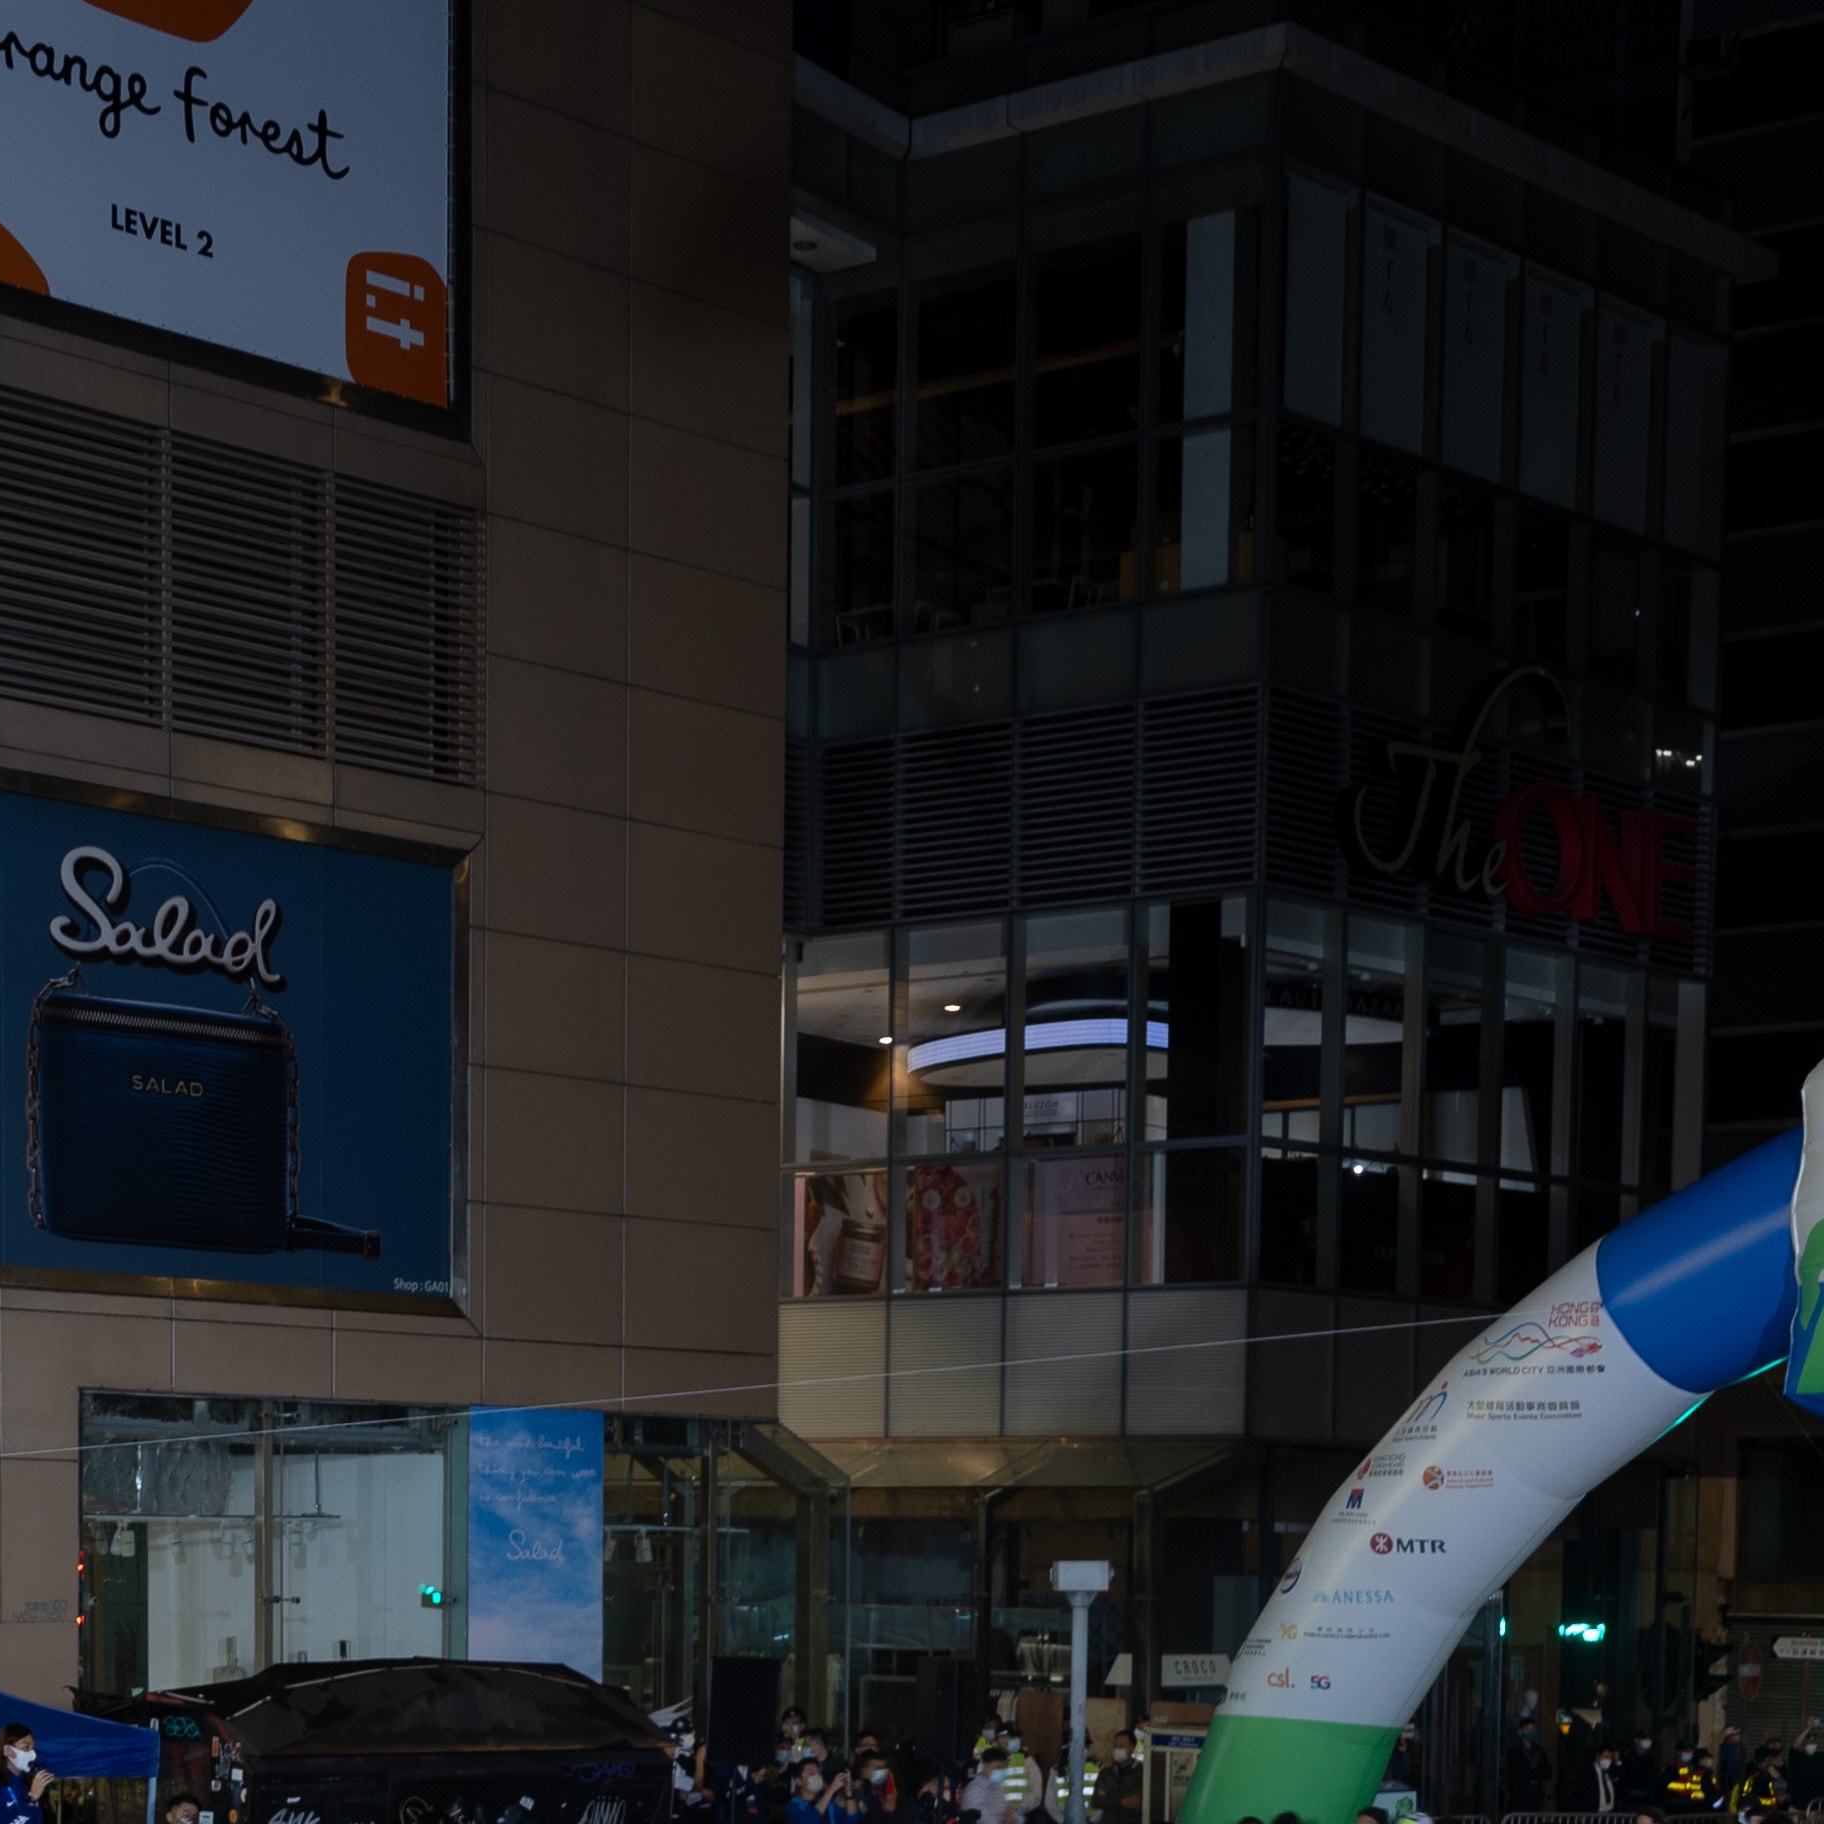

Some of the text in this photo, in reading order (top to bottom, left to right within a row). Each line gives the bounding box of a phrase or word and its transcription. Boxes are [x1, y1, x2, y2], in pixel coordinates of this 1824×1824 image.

[172, 65, 350, 181] forest
[110, 202, 214, 259] LEVEL 2
[1495, 783, 1697, 940] ONE
[49, 844, 283, 984] Salad
[131, 1074, 205, 1099] SALAD
[507, 1529, 566, 1561] Salad
[1396, 1538, 1447, 1554] MTR
[1332, 1589, 1395, 1605] ANESSA
[1310, 1675, 1332, 1690] 5G
